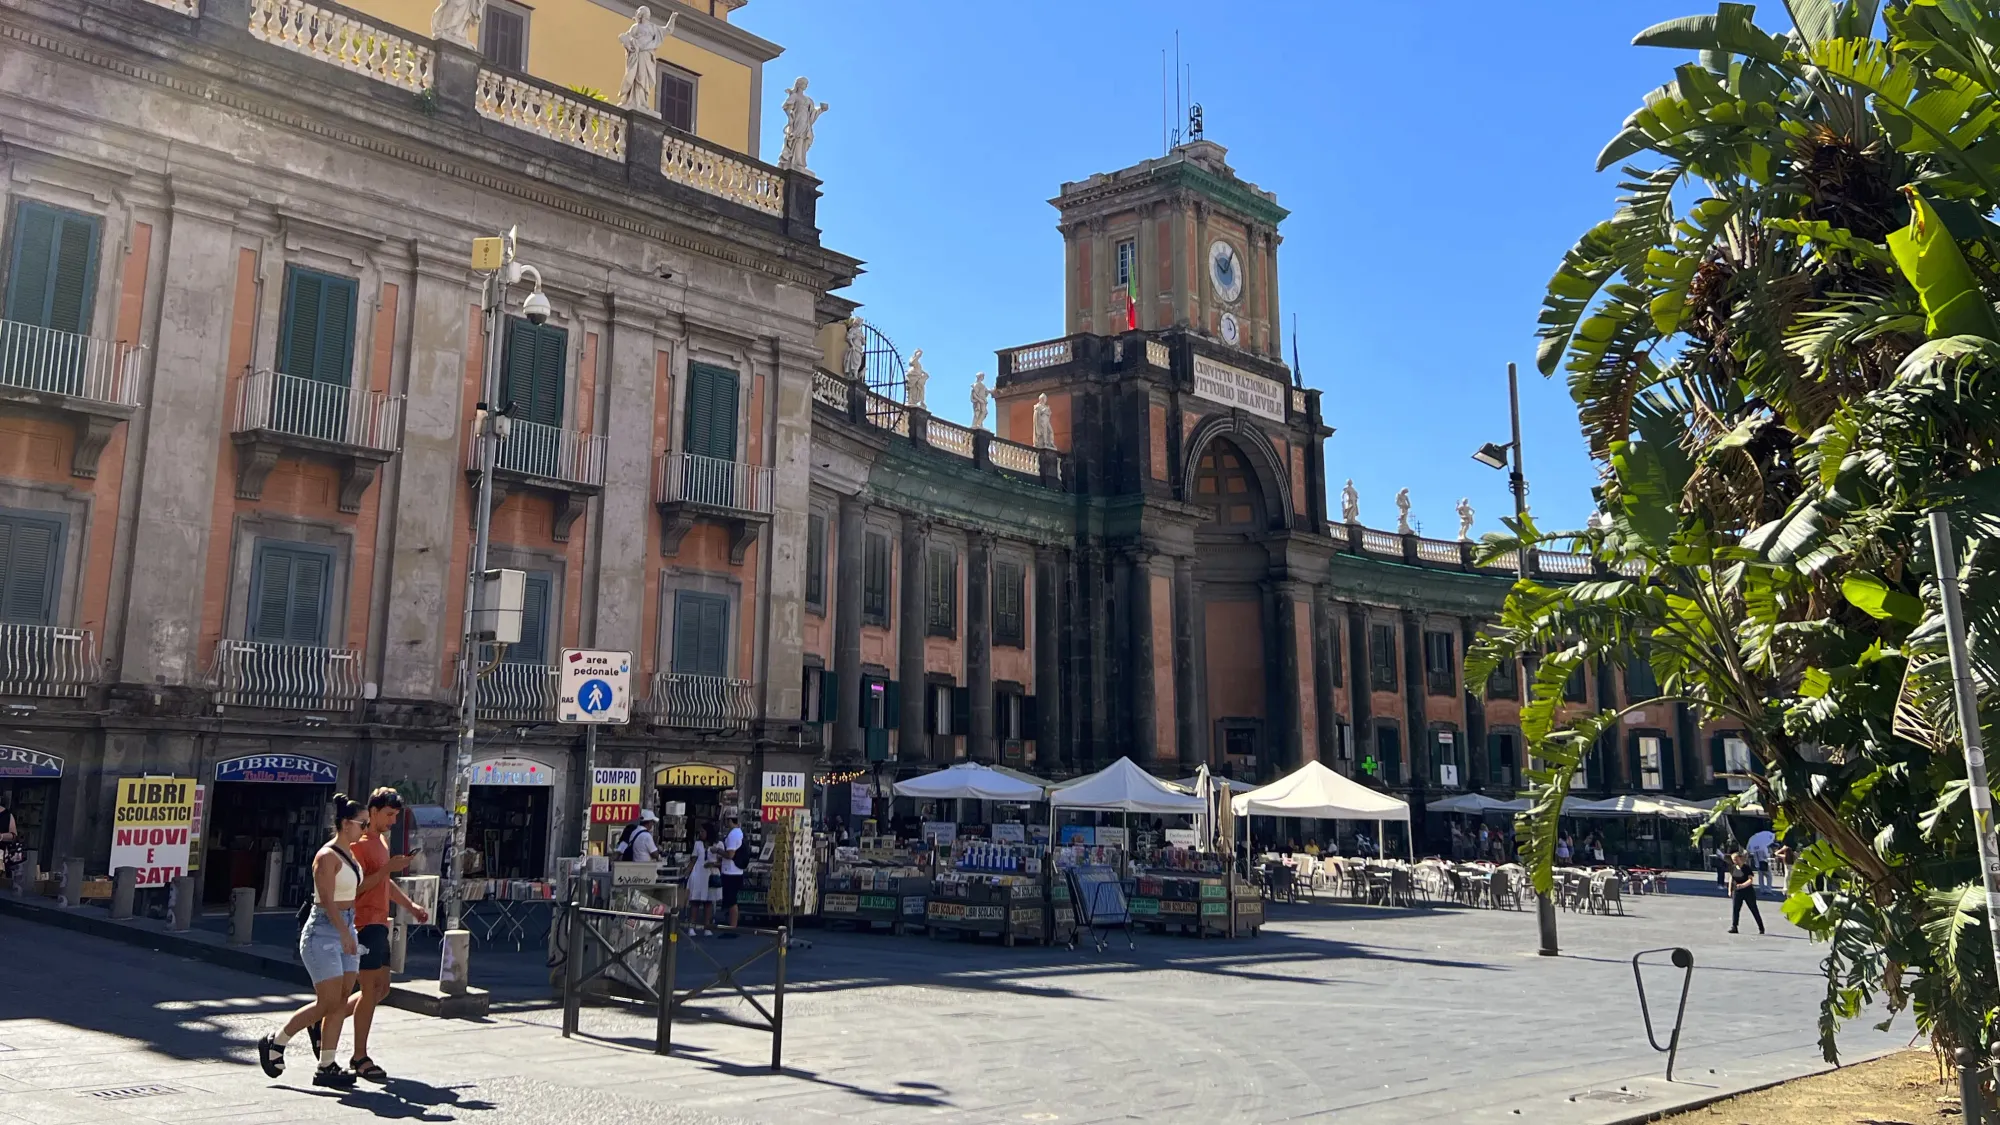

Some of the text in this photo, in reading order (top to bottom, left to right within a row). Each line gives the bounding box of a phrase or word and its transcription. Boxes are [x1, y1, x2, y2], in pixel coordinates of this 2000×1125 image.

[1195, 361, 1277, 398] CONVITTO NAZIONALE
[1194, 376, 1235, 400] VITTORIO
[574, 667, 619, 676] pedonale
[220, 756, 336, 778] LIBRERIA
[243, 771, 275, 781] Tullio
[595, 770, 637, 784] COMPRO
[665, 768, 728, 786] Libreria
[771, 774, 797, 787] LIBRI
[127, 783, 187, 804] LIBRI
[600, 788, 631, 802] LIBRI
[765, 791, 802, 803] SCOLASTICI
[117, 806, 192, 822] SCOLASTICI
[596, 806, 632, 820] USATI
[767, 807, 795, 820] USAT
[116, 828, 188, 846] NUOVI
[147, 848, 155, 863] E
[136, 866, 182, 885] SATI
